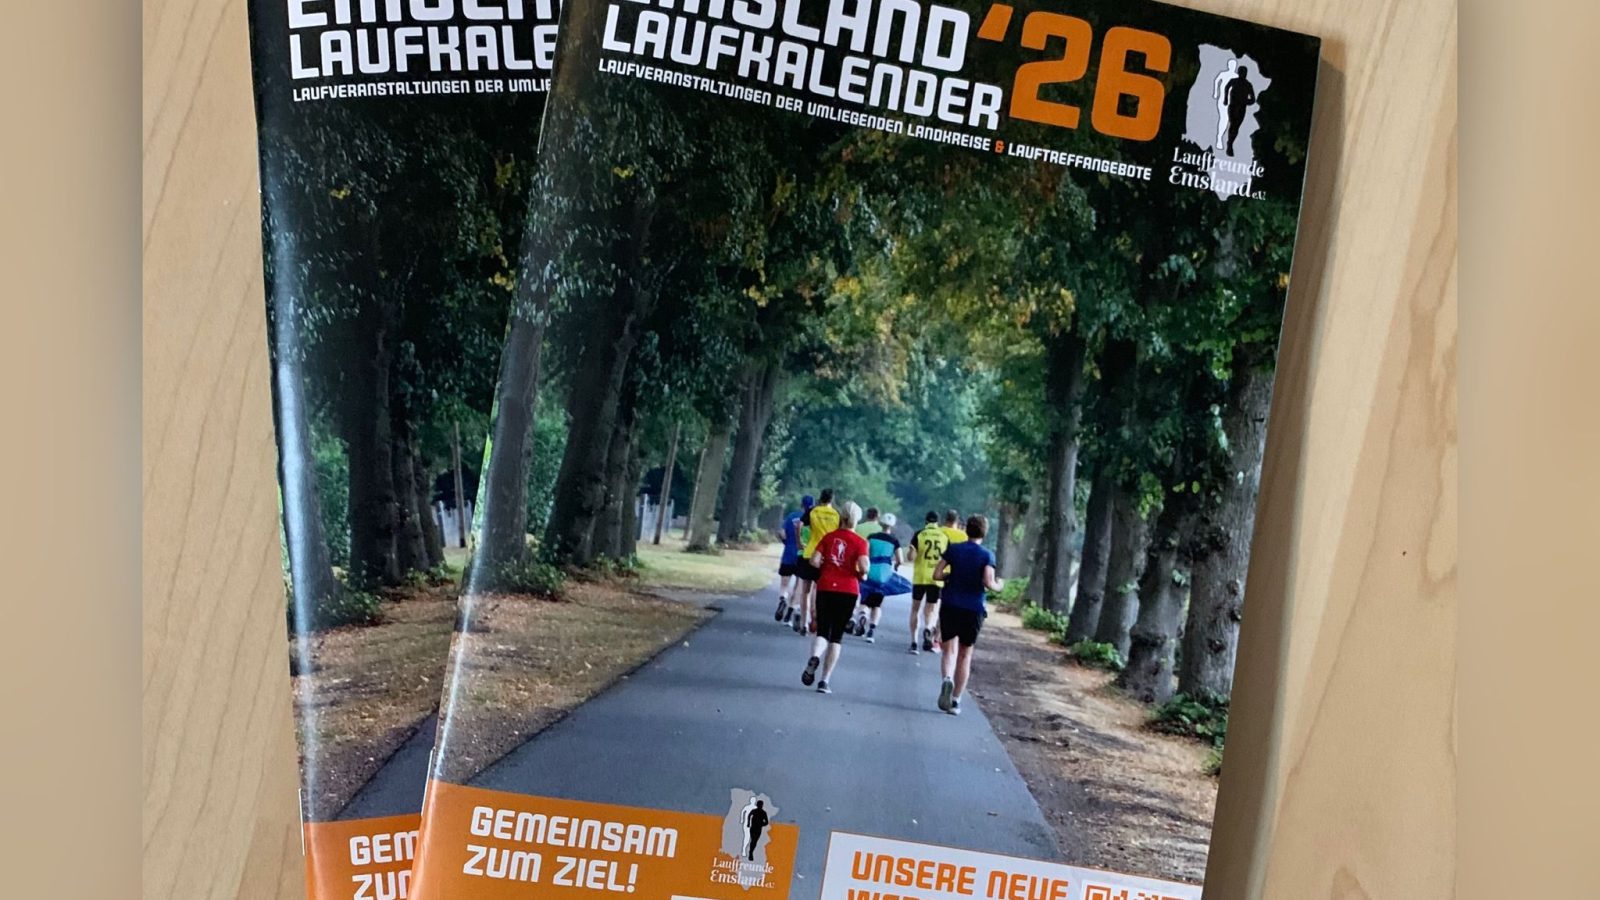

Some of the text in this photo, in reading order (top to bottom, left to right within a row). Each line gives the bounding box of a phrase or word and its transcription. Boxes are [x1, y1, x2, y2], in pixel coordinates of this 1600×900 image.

[601, 4, 1003, 131] LAUFKALENDER
[292, 79, 471, 102] LAUFVERANSTALTUNGEN
[474, 79, 504, 93] DER
[598, 57, 1152, 181] LAUFVERANSTALTUNGEN DER UMLIEGENDEN LANDKREISE & LAUFTREFFANGEBOTE
[1172, 147, 1265, 178] Lauffreunde
[1168, 165, 1252, 198] Emsland
[924, 539, 942, 560] 25
[470, 806, 678, 858] GEMEINSAM
[462, 844, 638, 893] ZUM ZIEL!
[710, 869, 766, 888] Emsland
[712, 857, 774, 873] Lauffreunde
[851, 851, 1068, 900] UNSERE NEUE
